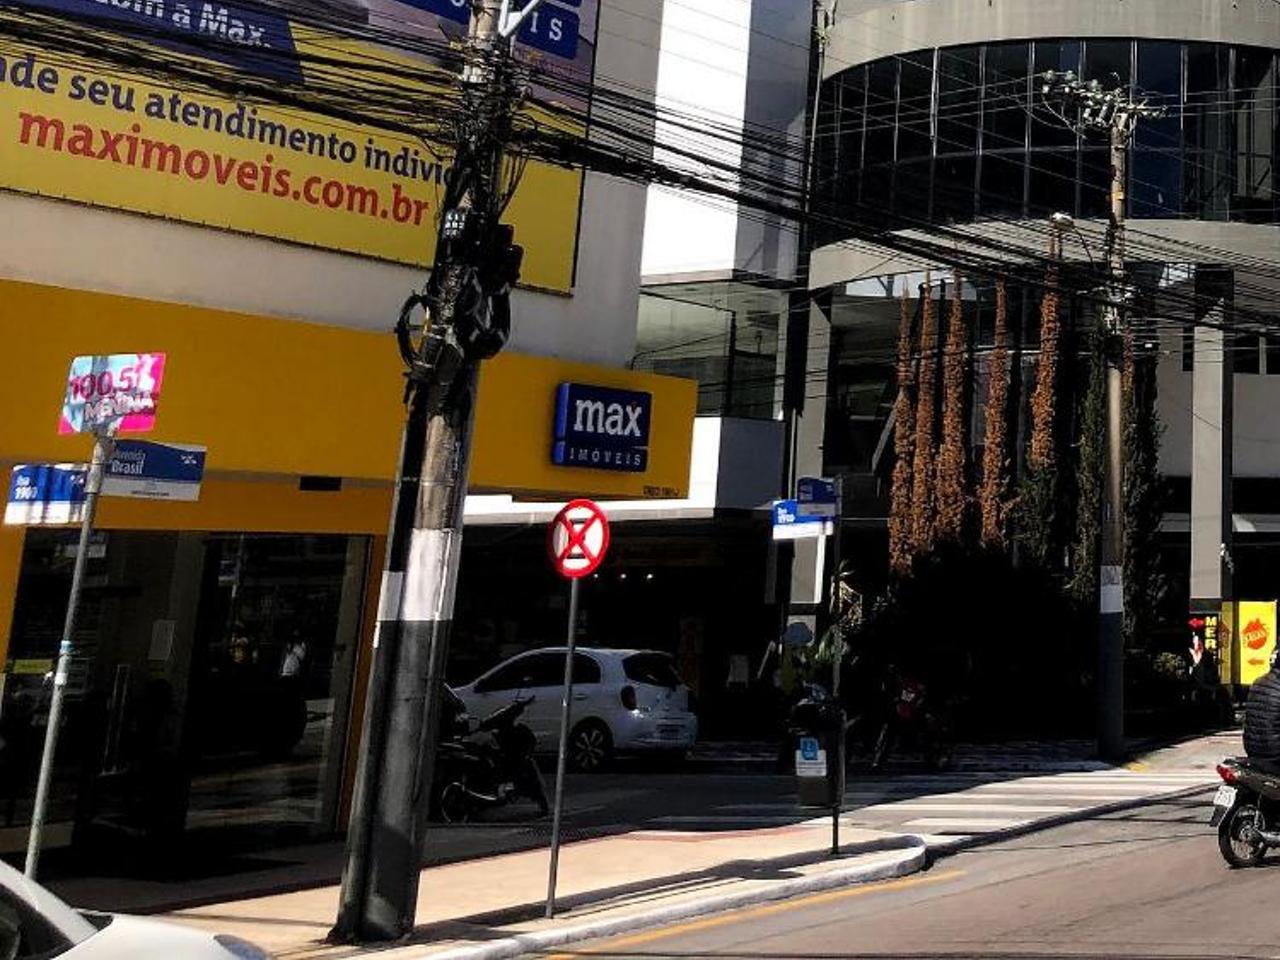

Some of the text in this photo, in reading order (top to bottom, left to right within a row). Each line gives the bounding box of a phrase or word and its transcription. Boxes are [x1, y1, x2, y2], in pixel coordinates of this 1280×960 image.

[0, 56, 58, 94] de
[68, 73, 135, 113] seu
[145, 92, 357, 164] atendimento
[18, 110, 431, 227] maximoveis.com.br
[573, 397, 643, 438] max
[111, 458, 145, 475] Brasil
[568, 445, 642, 468] IMÓVEIS
